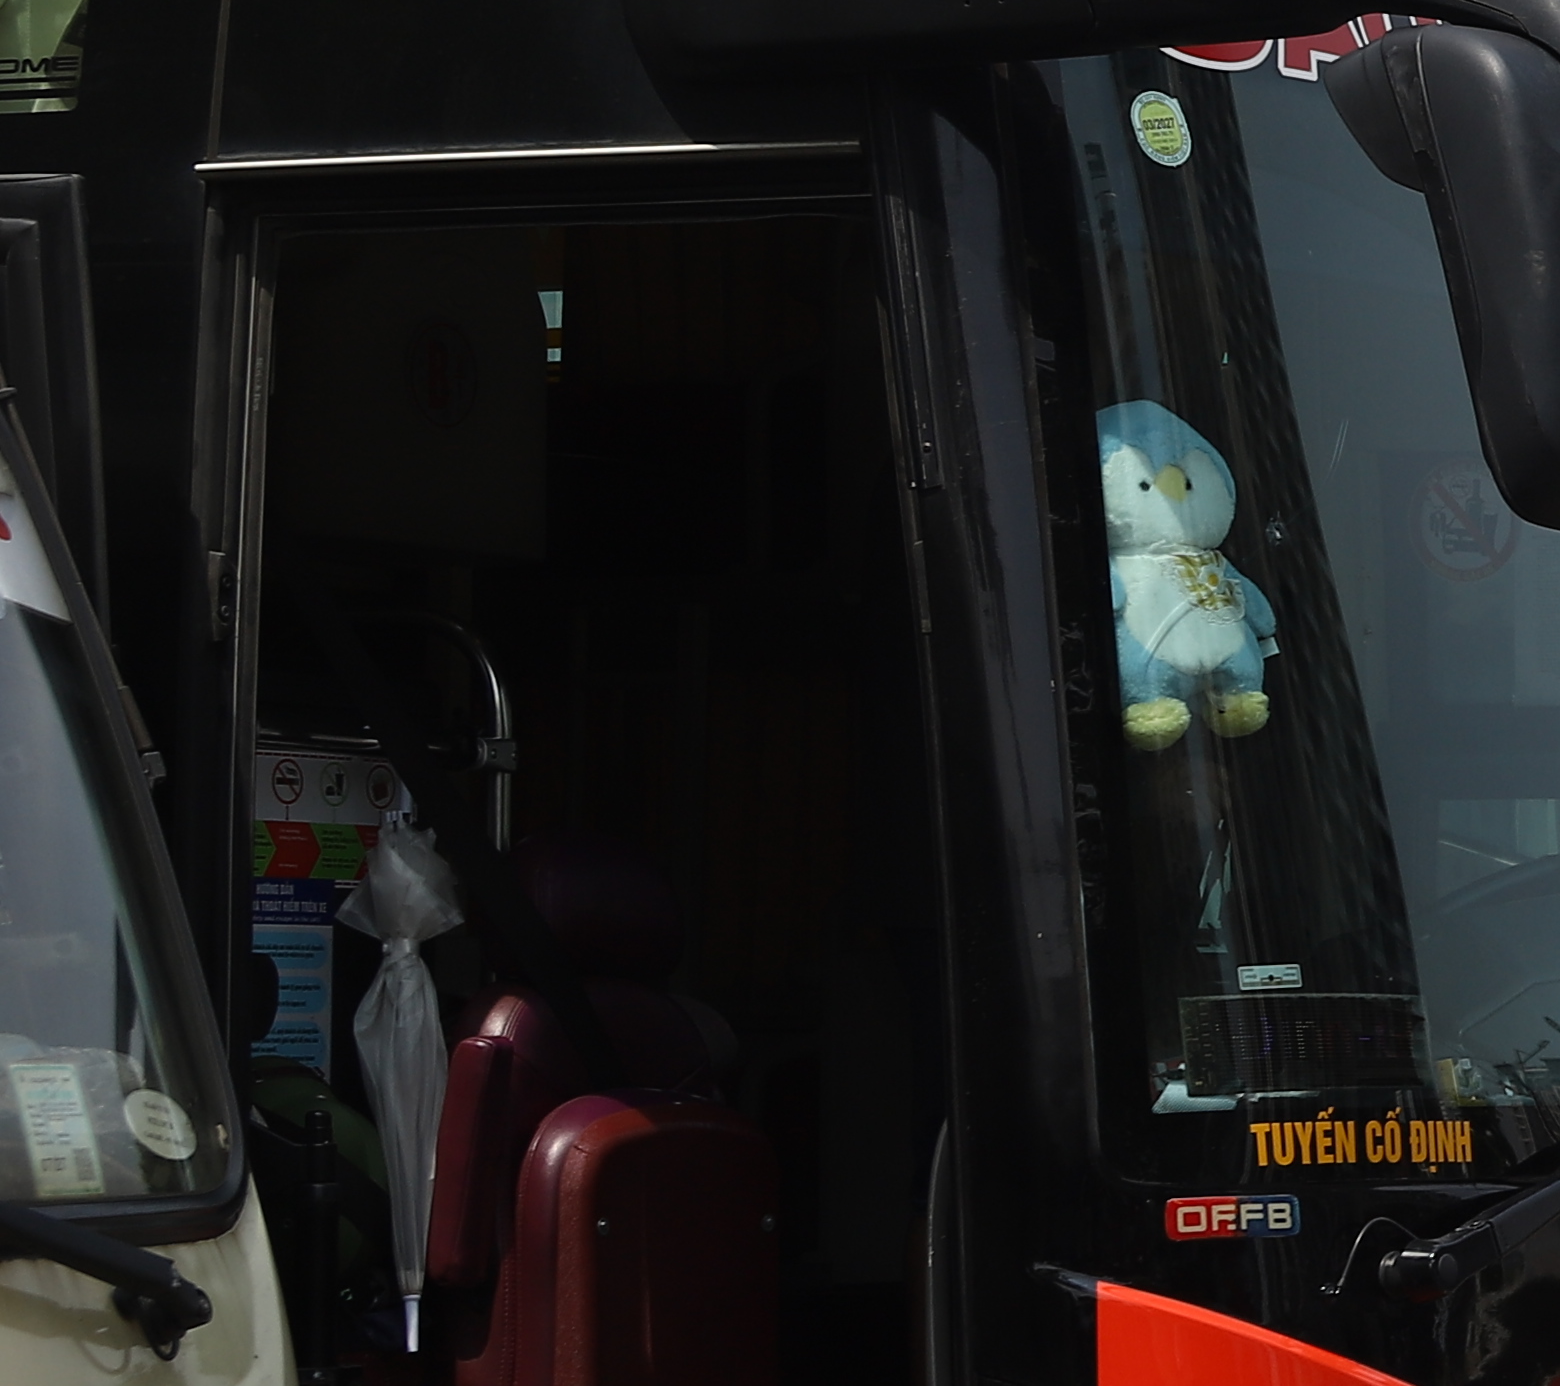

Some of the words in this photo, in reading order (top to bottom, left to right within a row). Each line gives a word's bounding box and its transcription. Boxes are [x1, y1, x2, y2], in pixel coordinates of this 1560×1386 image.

[1250, 1107, 1356, 1167] TUYẾN
[1365, 1107, 1402, 1164] CỐ
[1409, 1120, 1472, 1174] ĐỊNH
